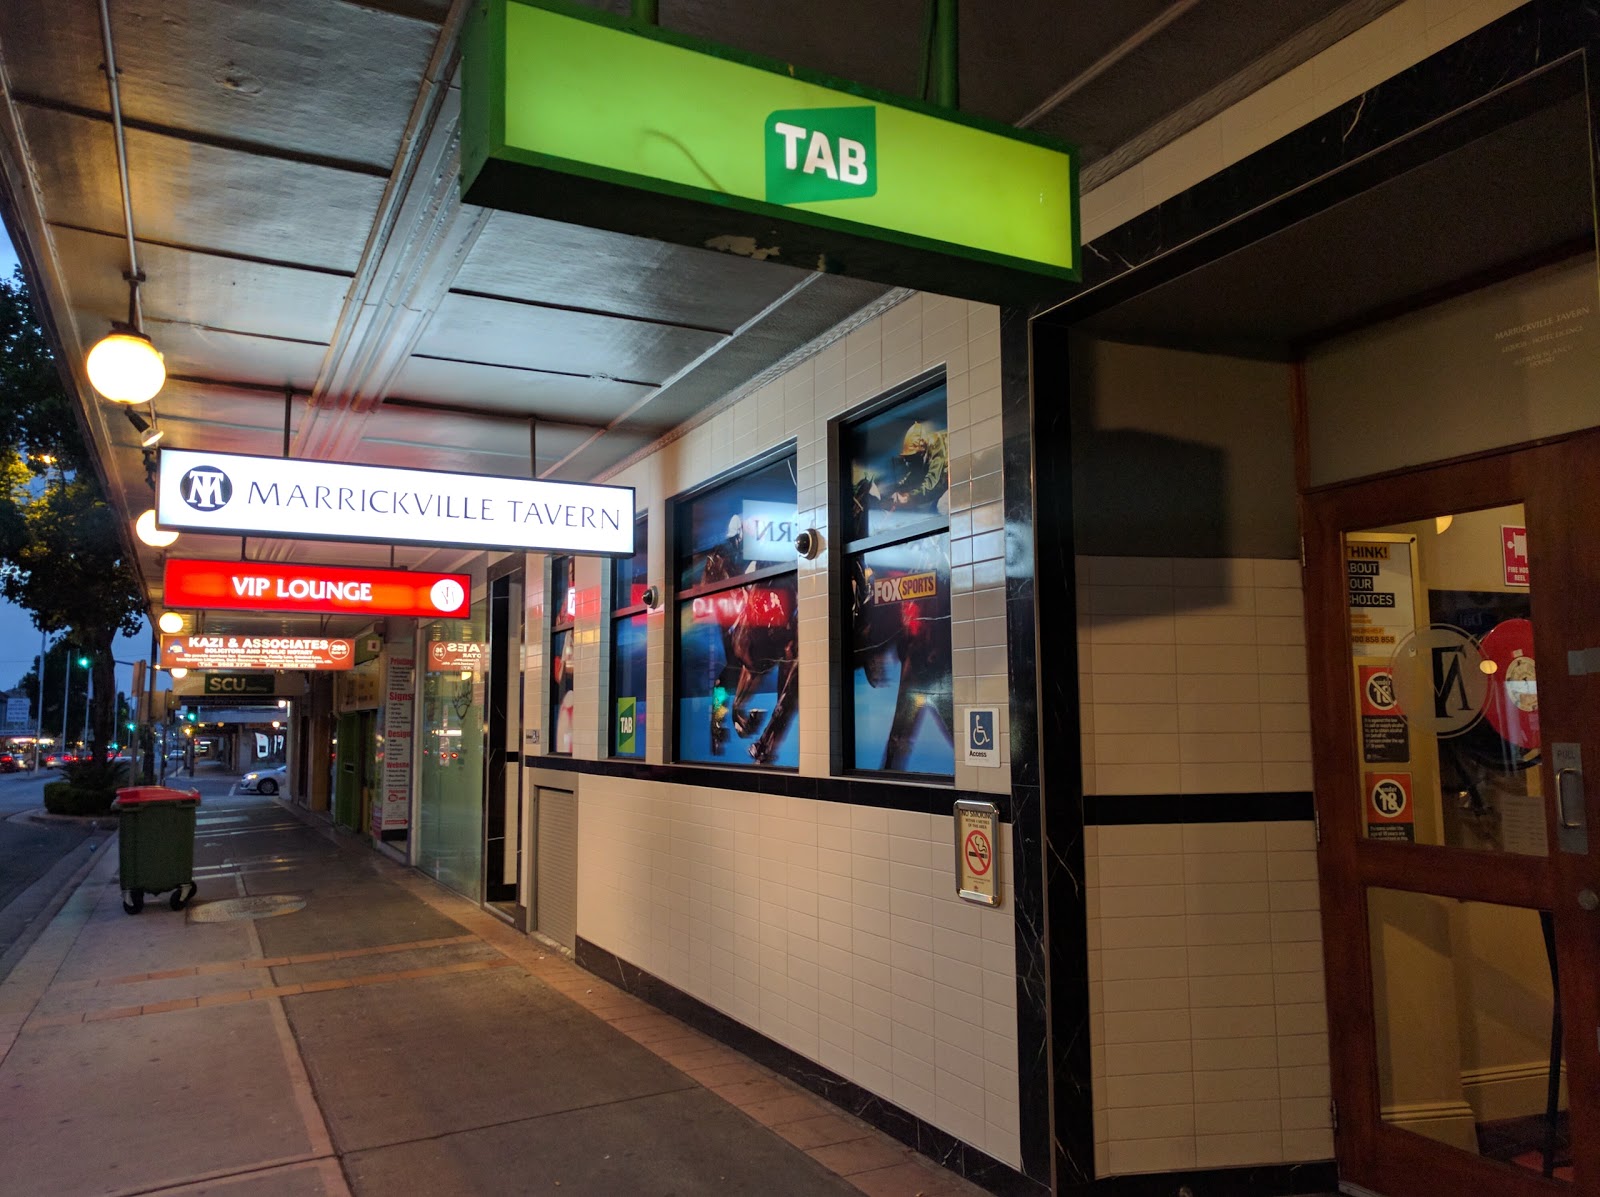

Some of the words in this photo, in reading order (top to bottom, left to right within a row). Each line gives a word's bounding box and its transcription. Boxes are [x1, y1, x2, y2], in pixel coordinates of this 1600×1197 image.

[775, 121, 868, 186] TAB
[1495, 317, 1553, 341] MARRICKVILLE
[1556, 306, 1590, 322] TAVERN
[248, 480, 495, 523] MARRICKVILLE
[507, 499, 622, 531] TAVERN
[1348, 563, 1378, 574] BOUT
[232, 576, 271, 597] VIP
[277, 579, 373, 601] LOUNGE
[874, 578, 902, 604] FOX
[902, 576, 934, 596] SPORTS
[1350, 578, 1372, 589] OUR
[1350, 594, 1393, 605] HOICES
[189, 636, 224, 648] KAZI
[228, 638, 239, 649] &
[244, 638, 329, 650] ASSOCIATES
[210, 678, 246, 691] SCU
[389, 691, 412, 702] Signs
[620, 716, 633, 734] TAB
[969, 750, 986, 758] Access
[386, 761, 409, 769] Website
[1379, 792, 1398, 811] 18
